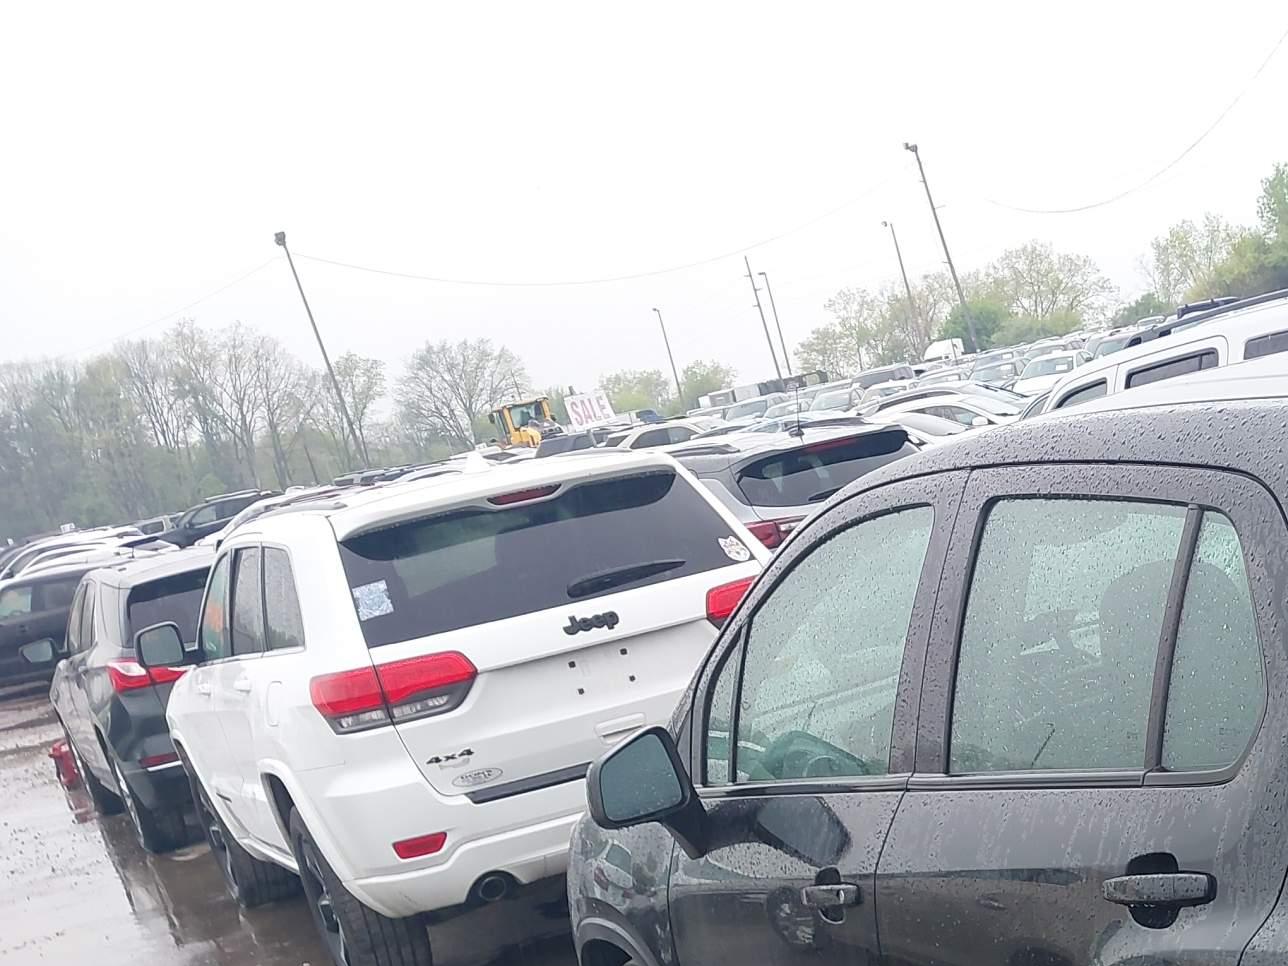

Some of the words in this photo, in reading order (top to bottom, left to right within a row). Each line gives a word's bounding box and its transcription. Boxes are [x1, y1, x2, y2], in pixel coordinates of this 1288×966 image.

[570, 396, 611, 425] SALE
[563, 611, 619, 635] Jeep
[426, 749, 475, 764] 4x4
